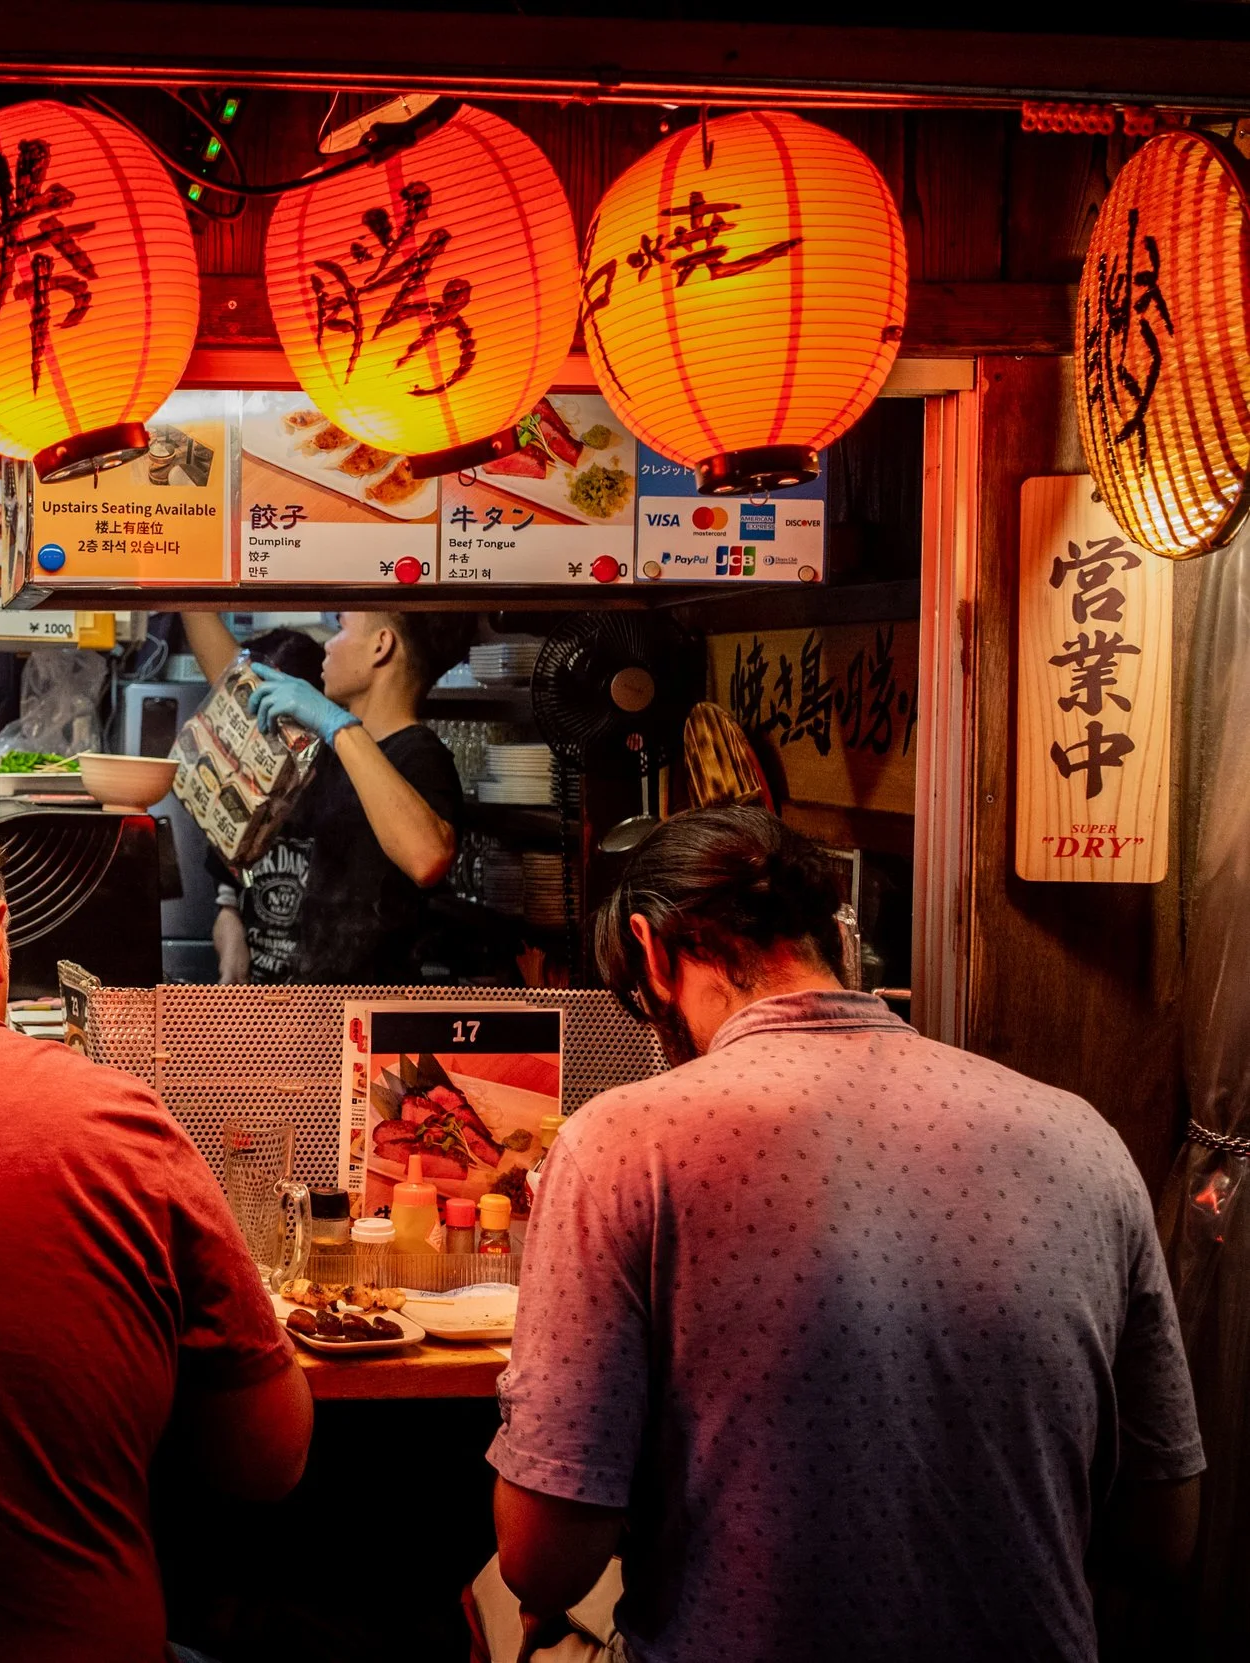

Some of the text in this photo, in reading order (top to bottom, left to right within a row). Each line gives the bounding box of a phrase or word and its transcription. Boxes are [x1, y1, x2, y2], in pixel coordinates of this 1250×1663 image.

[42, 500, 216, 517] Upstairs Seating Available
[249, 503, 309, 531] 餃子
[450, 505, 535, 532] 牛タン
[645, 513, 681, 527] VISA
[740, 515, 774, 523] AMERICAN
[785, 519, 821, 527] DISCOVER
[95, 520, 164, 535] 楼上有座位
[746, 523, 775, 531] EXPRESS
[78, 540, 180, 555] 2층 좌석 있습니다
[249, 536, 301, 548] Dumpling
[449, 539, 516, 550] Beef Tongue
[248, 551, 270, 562] 饺子
[448, 553, 470, 564] 牛舌
[674, 554, 709, 566] PayPal
[248, 566, 269, 578] 만두
[448, 569, 492, 580] 소고기 혀
[44, 623, 72, 634] 1000
[1048, 536, 1143, 800] 営業中
[1070, 823, 1118, 834] SUPER
[452, 1020, 481, 1042] 17
